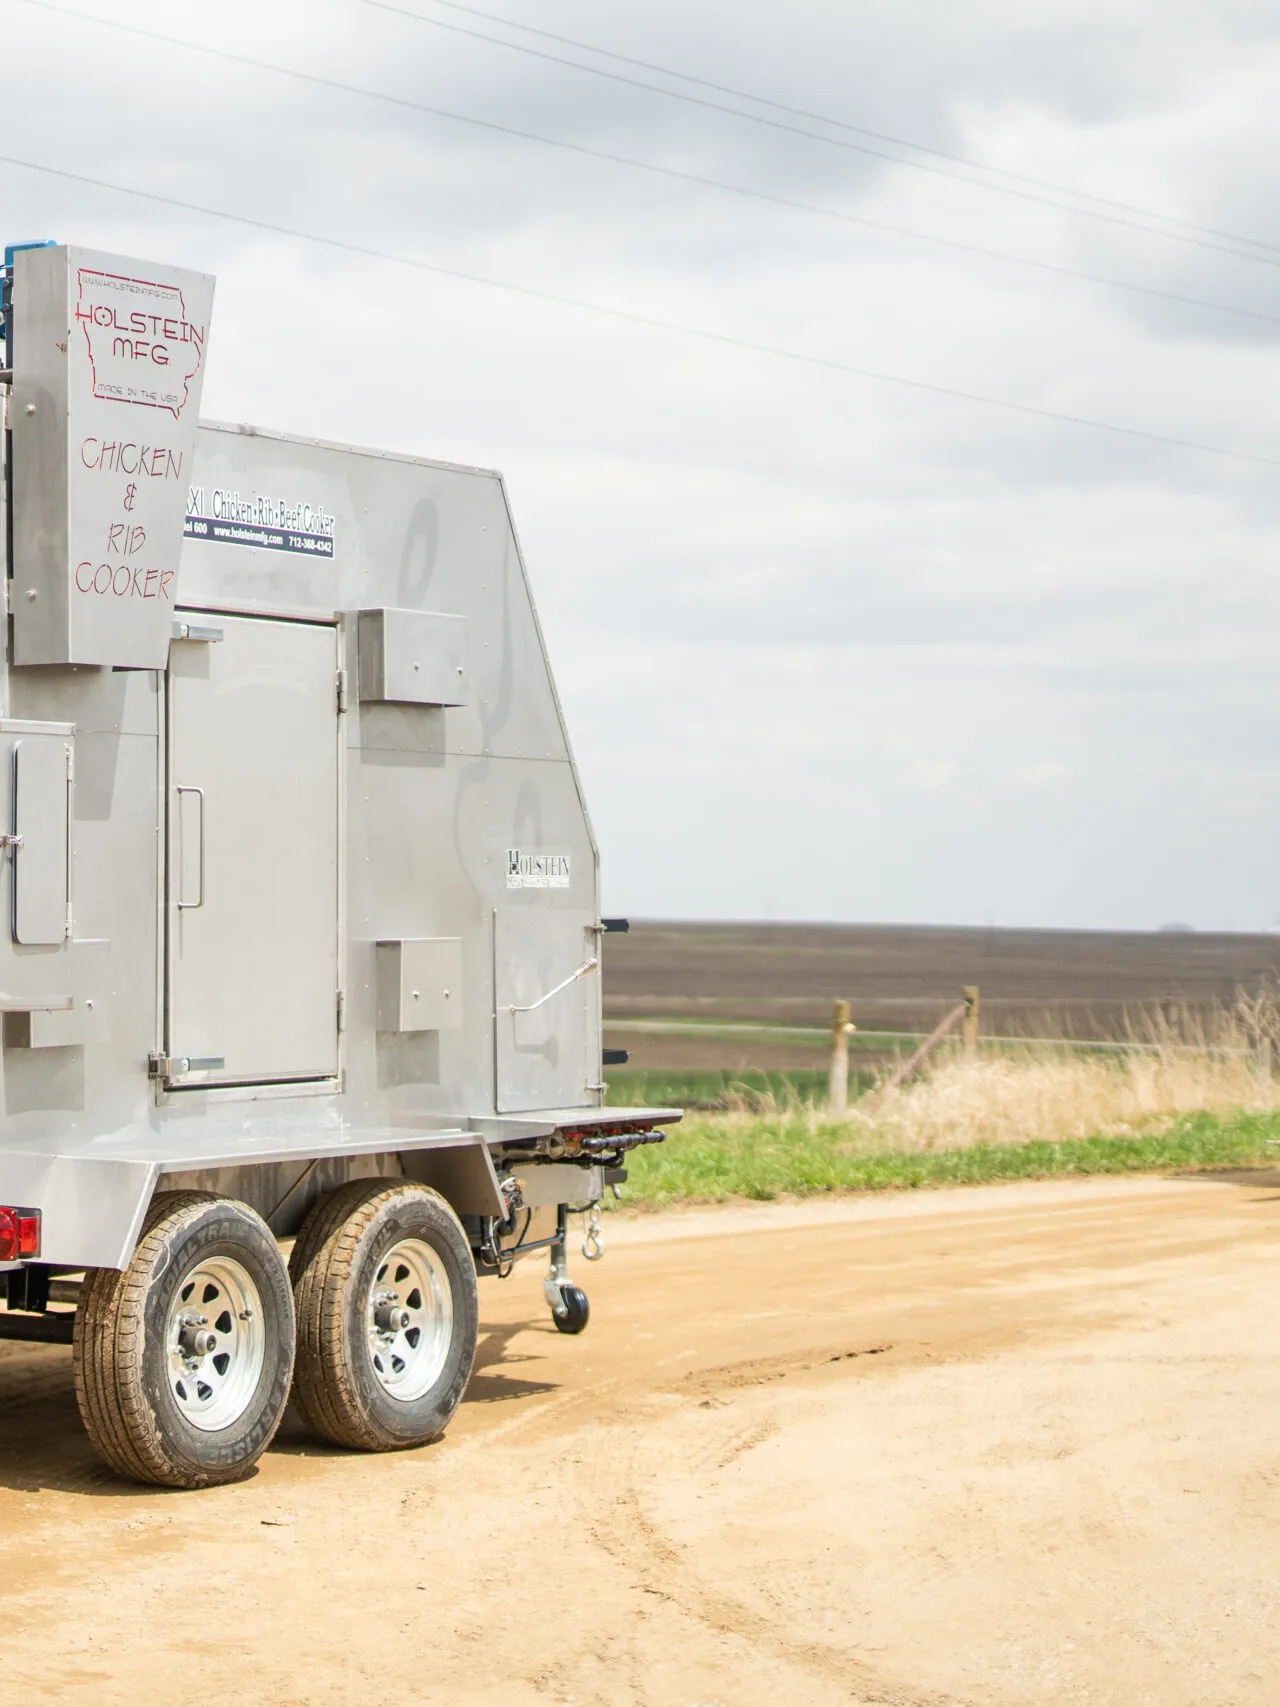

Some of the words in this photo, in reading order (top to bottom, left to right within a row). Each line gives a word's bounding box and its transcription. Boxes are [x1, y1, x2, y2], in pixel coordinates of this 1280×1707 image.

[75, 302, 205, 345] HOLSTEIN
[113, 337, 169, 365] MFG
[97, 383, 124, 395] MADE
[127, 387, 137, 397] IN
[140, 389, 158, 401] THE
[161, 393, 178, 403] USA
[81, 437, 183, 480] CHICKEN
[123, 482, 138, 512] &
[193, 521, 207, 535] 600
[304, 505, 334, 536] Cooker
[107, 523, 146, 556] RIB
[75, 562, 175, 600] COOKER
[508, 850, 569, 876] HOLSTEIN
